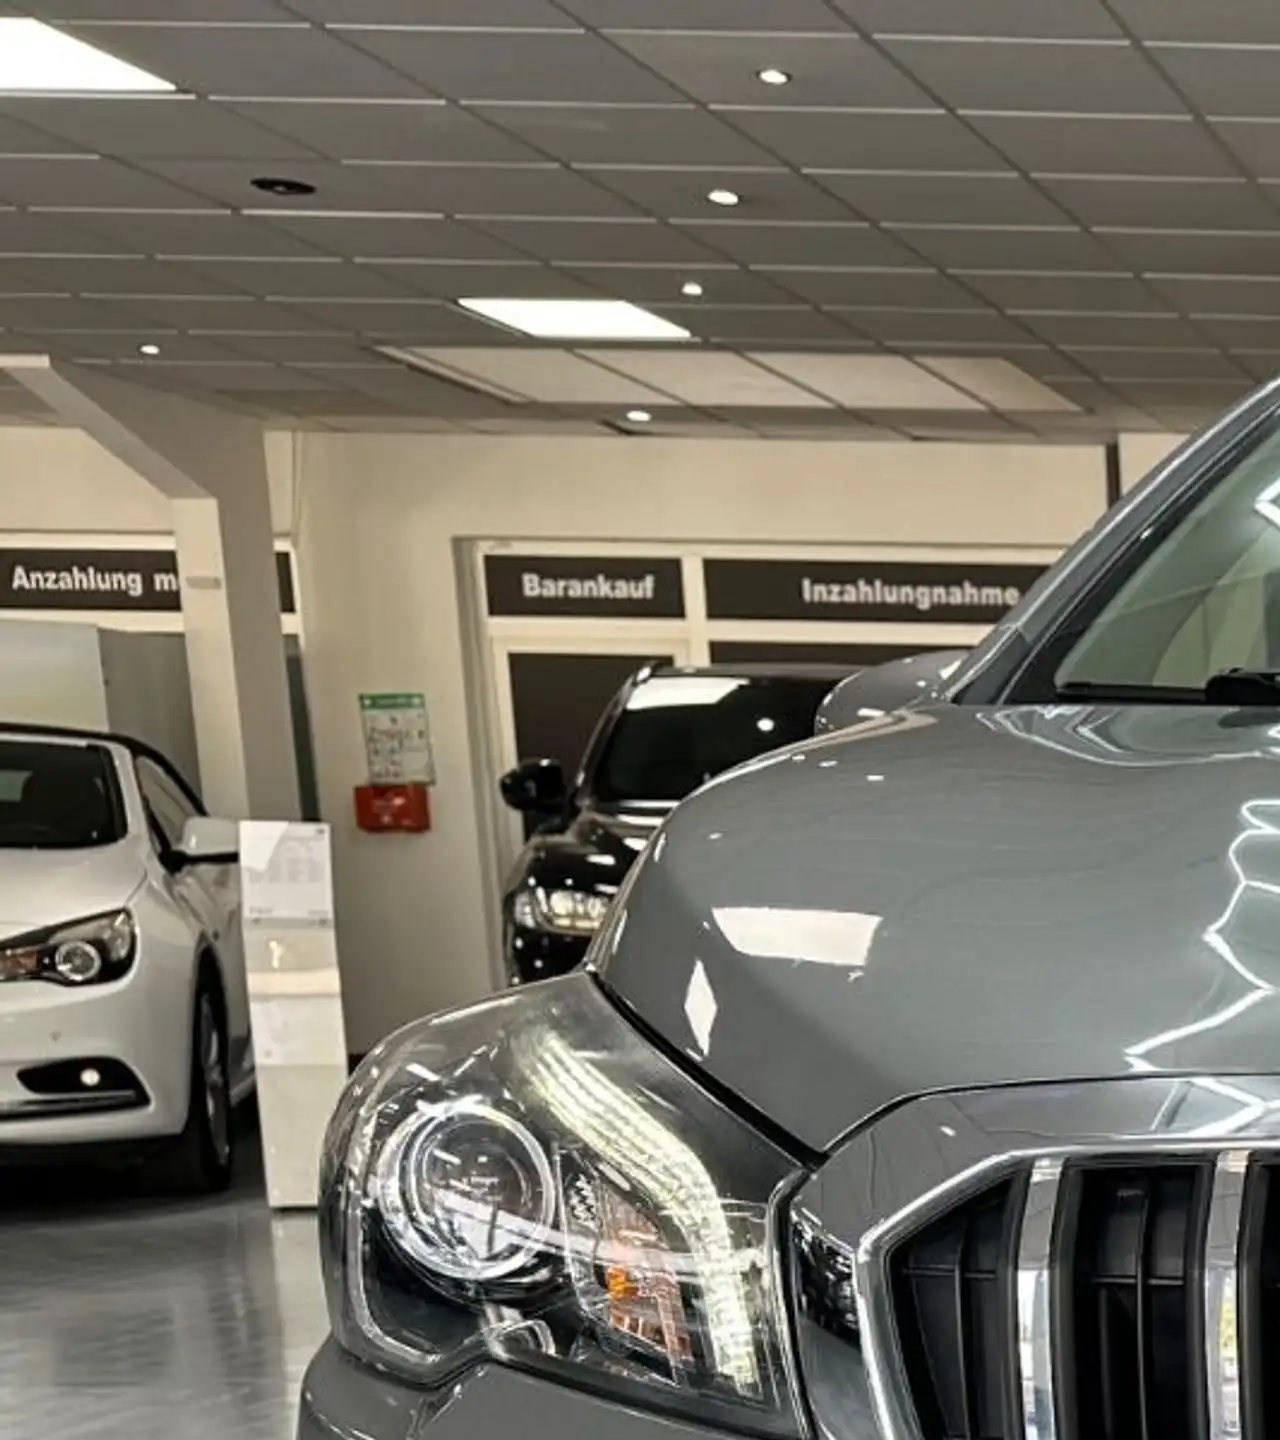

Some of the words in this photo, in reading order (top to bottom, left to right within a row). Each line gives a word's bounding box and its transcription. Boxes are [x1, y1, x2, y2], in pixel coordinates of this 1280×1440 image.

[12, 564, 143, 597] Anzahlung
[522, 572, 655, 600] Barankauf
[802, 577, 1021, 611] Inzahlungnahme
